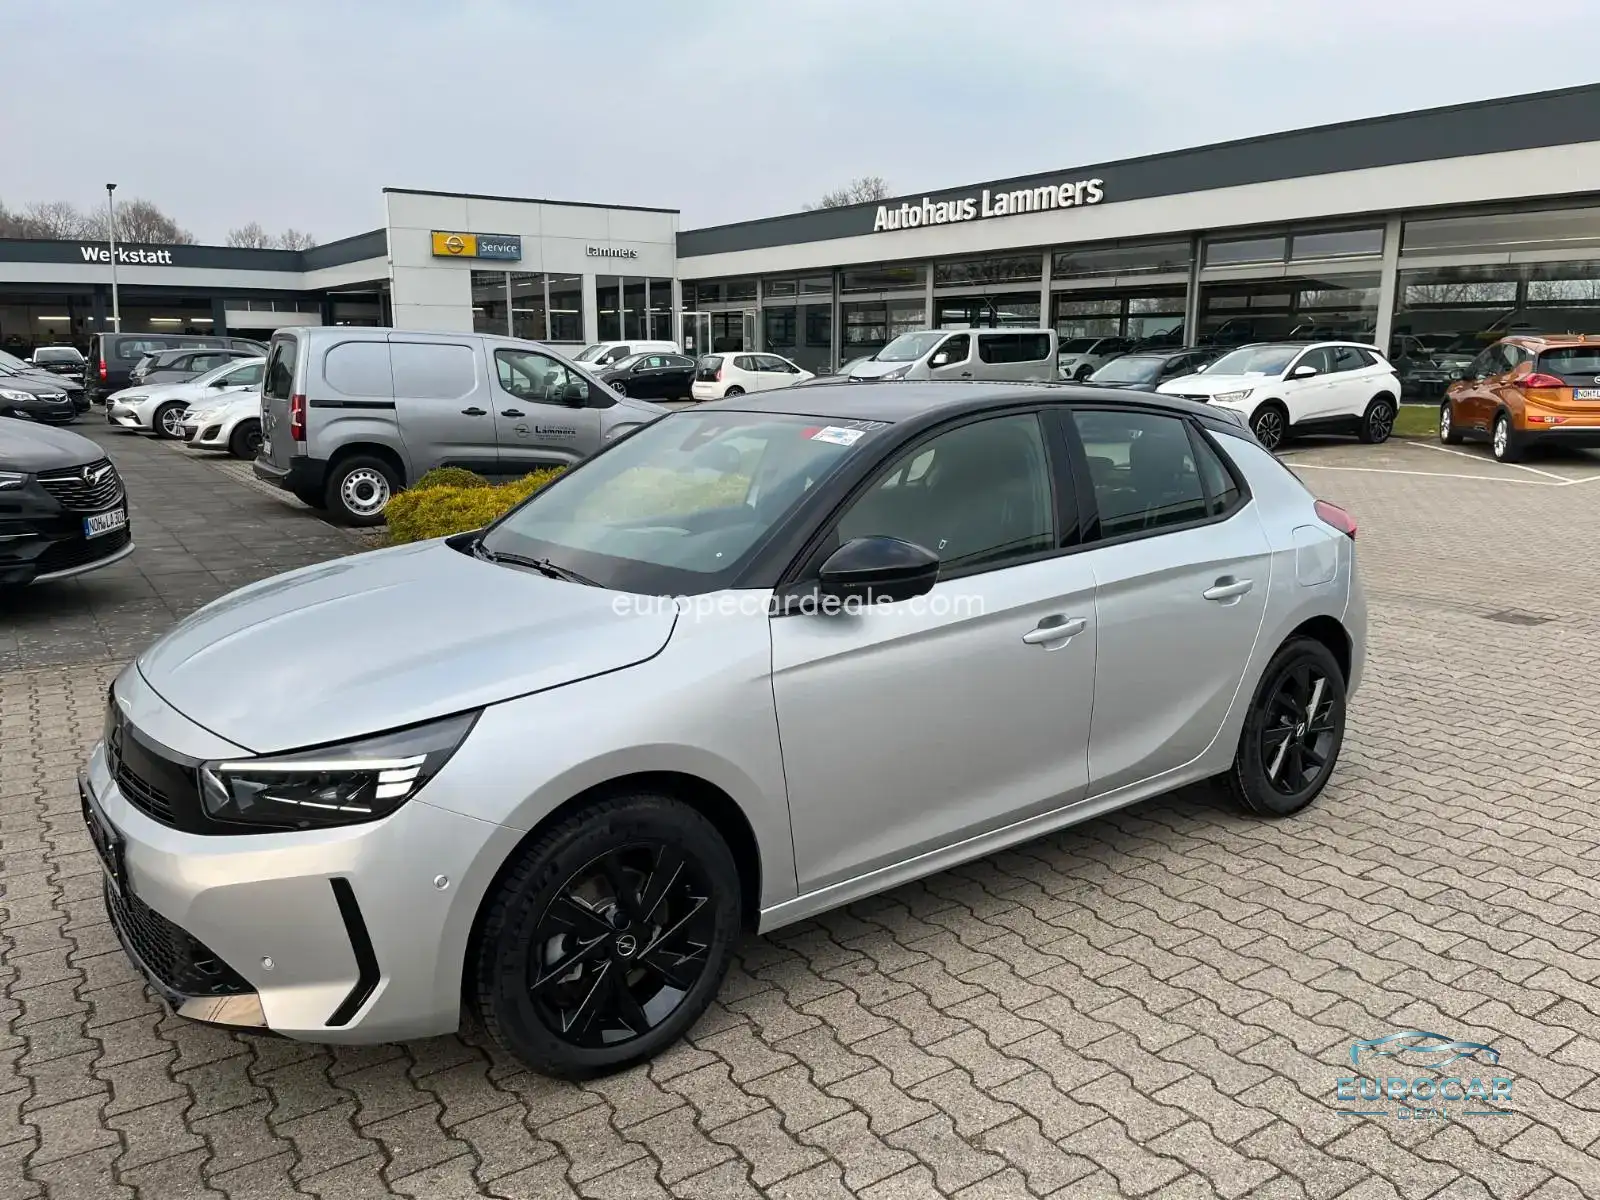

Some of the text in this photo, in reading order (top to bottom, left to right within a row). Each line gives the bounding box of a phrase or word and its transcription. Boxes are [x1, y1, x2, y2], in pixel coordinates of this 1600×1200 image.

[873, 178, 1104, 232] Autohaus Lammers
[481, 242, 518, 253] Service
[586, 243, 638, 258] Lammers
[535, 425, 577, 435] Lammers
